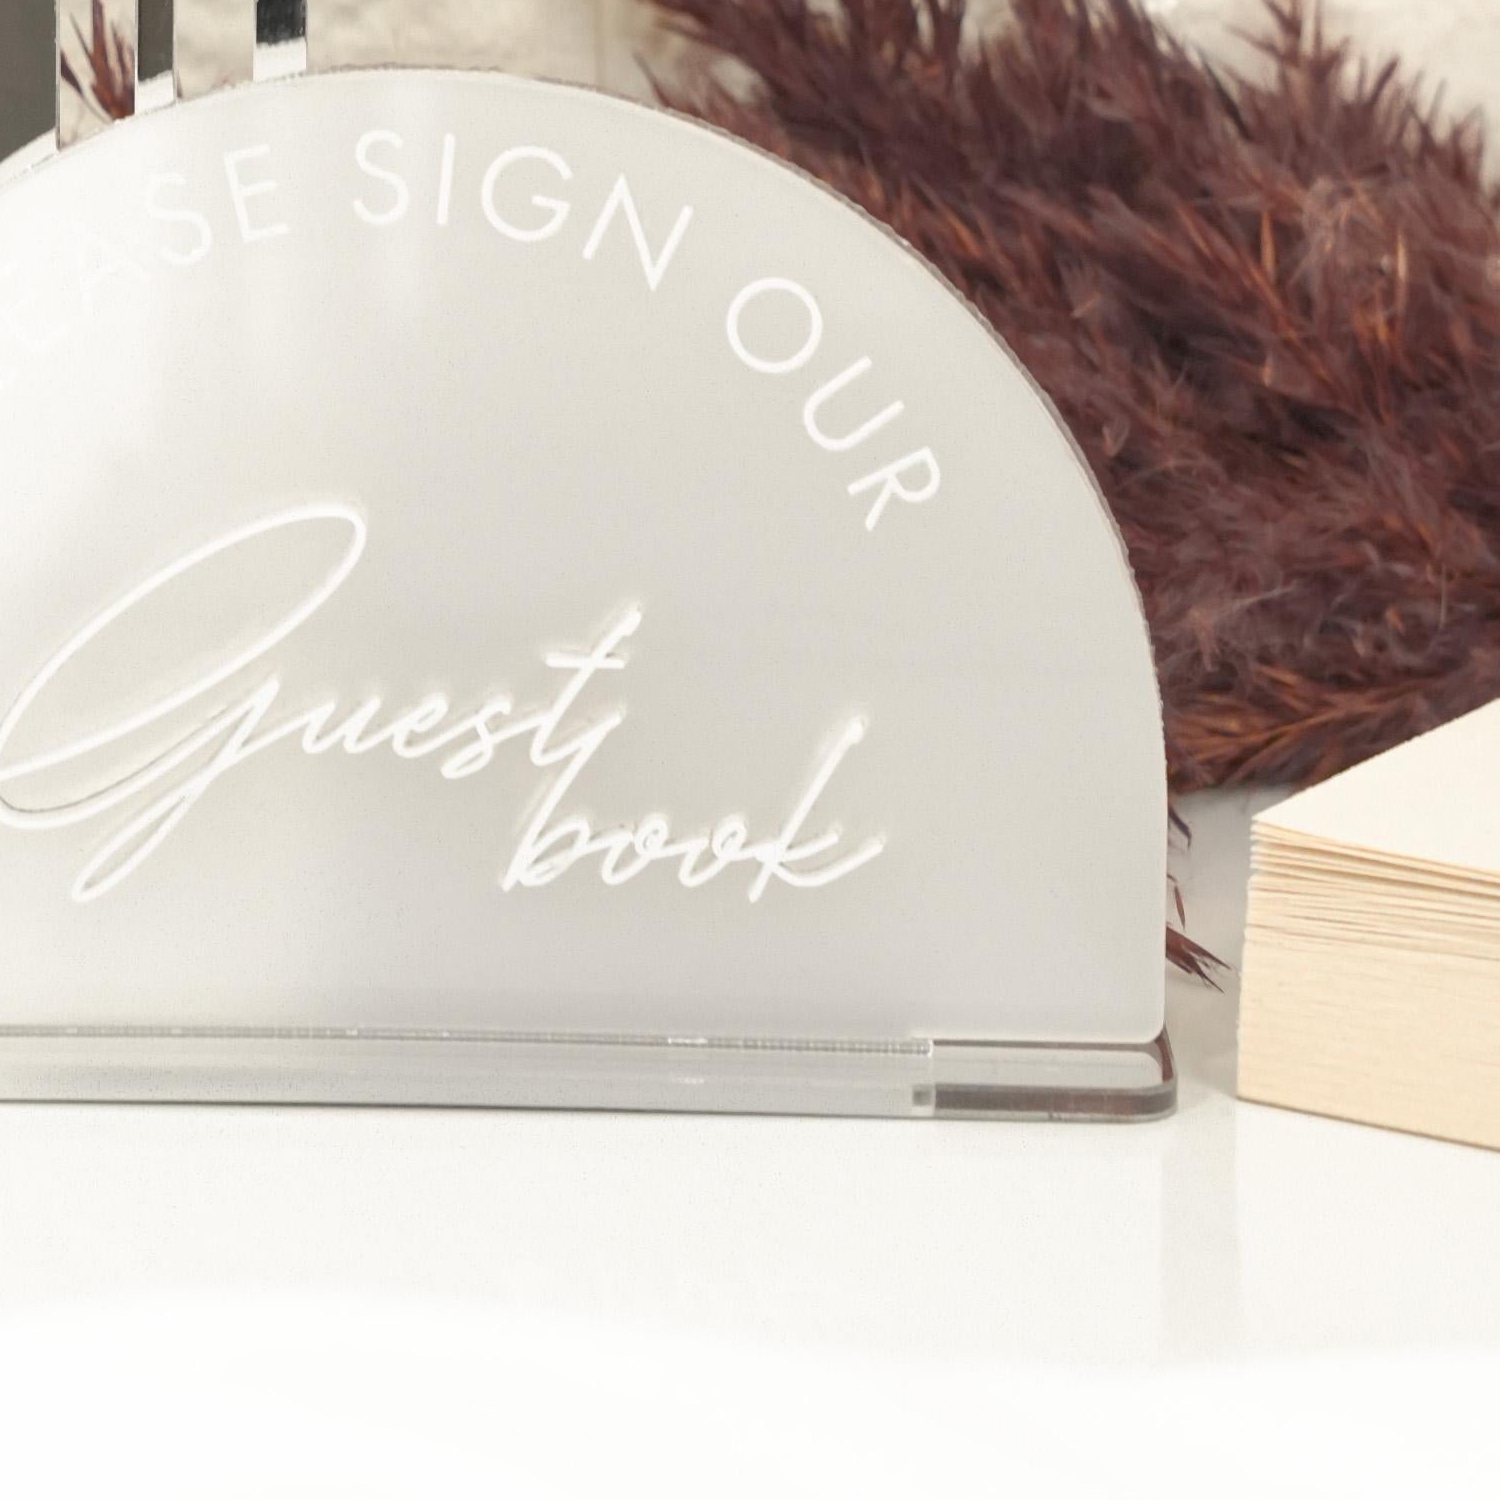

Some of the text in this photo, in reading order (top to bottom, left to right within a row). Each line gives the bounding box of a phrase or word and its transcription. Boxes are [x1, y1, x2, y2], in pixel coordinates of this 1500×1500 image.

[351, 128, 695, 292] SIGN
[725, 276, 942, 532] OUR
[500, 704, 888, 902] book
